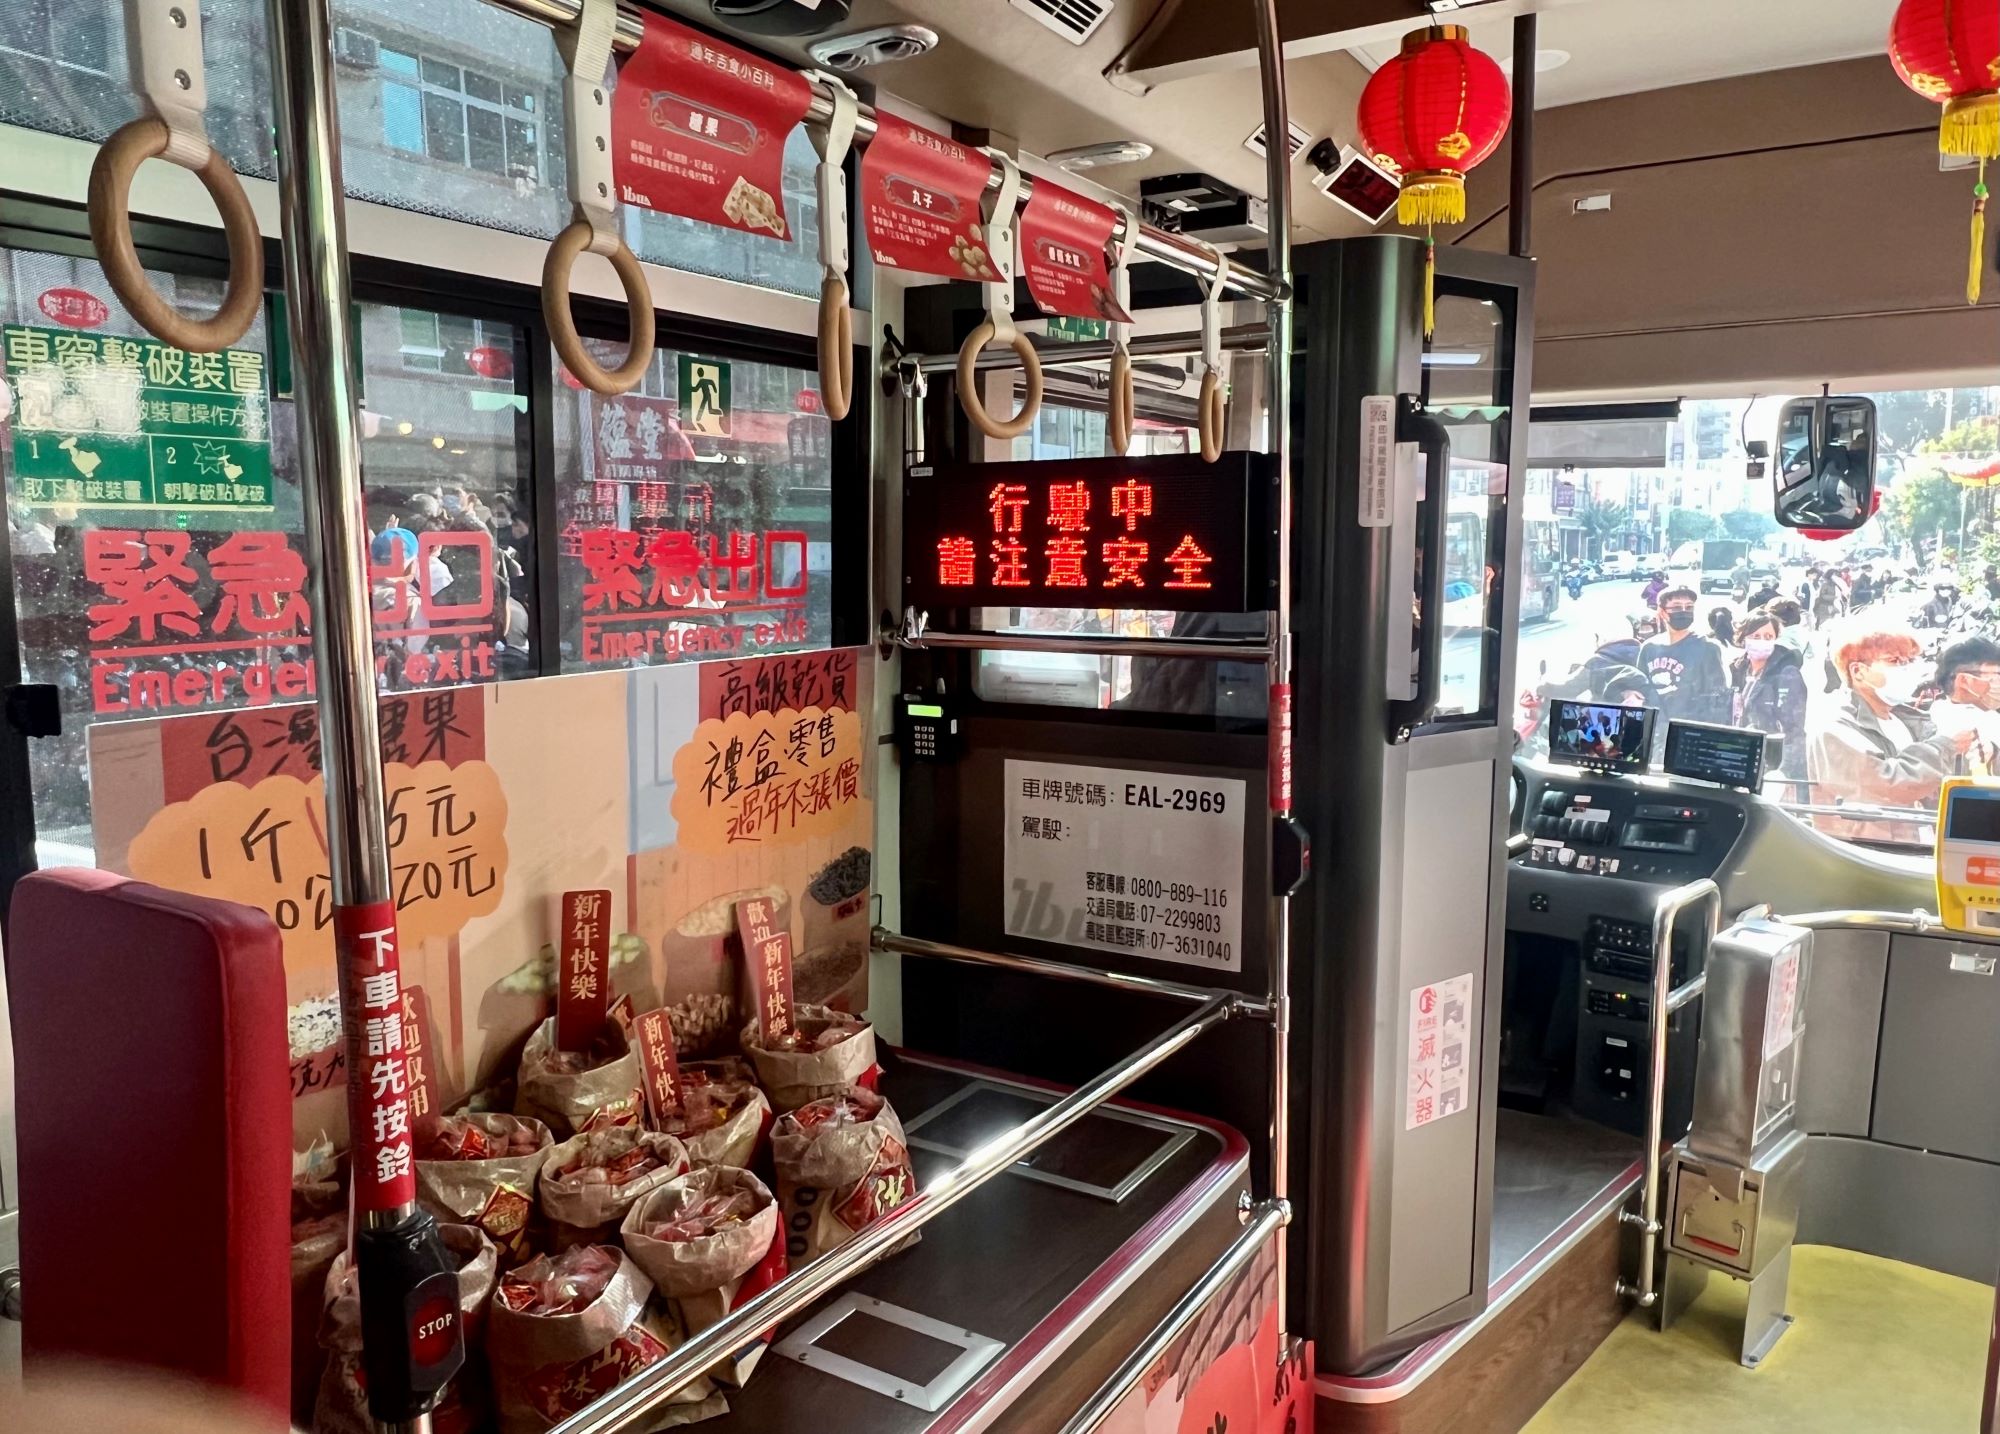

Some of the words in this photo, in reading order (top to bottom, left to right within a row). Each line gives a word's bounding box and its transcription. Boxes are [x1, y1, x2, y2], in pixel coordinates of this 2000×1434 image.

[912, 189, 933, 209] 丸子
[4, 327, 263, 392] 車窗擊破裝置
[31, 439, 39, 459] 1
[166, 446, 177, 464] 2
[581, 531, 808, 611] 緊急出口
[404, 636, 495, 684] exit
[583, 626, 746, 663] Emergency
[754, 612, 808, 647] exit
[718, 652, 852, 723] 高級乾貨
[700, 713, 837, 808] 禮盒零售
[1022, 778, 1115, 807] 車牌號碼:
[1125, 784, 1226, 814] EAL-2969
[1021, 815, 1071, 841] 駕駛:
[570, 893, 602, 1000] 新年快樂
[359, 926, 411, 1184] 下車請先按鈴
[1416, 1033, 1436, 1123] 滅火器
[418, 1313, 452, 1339] STOP
